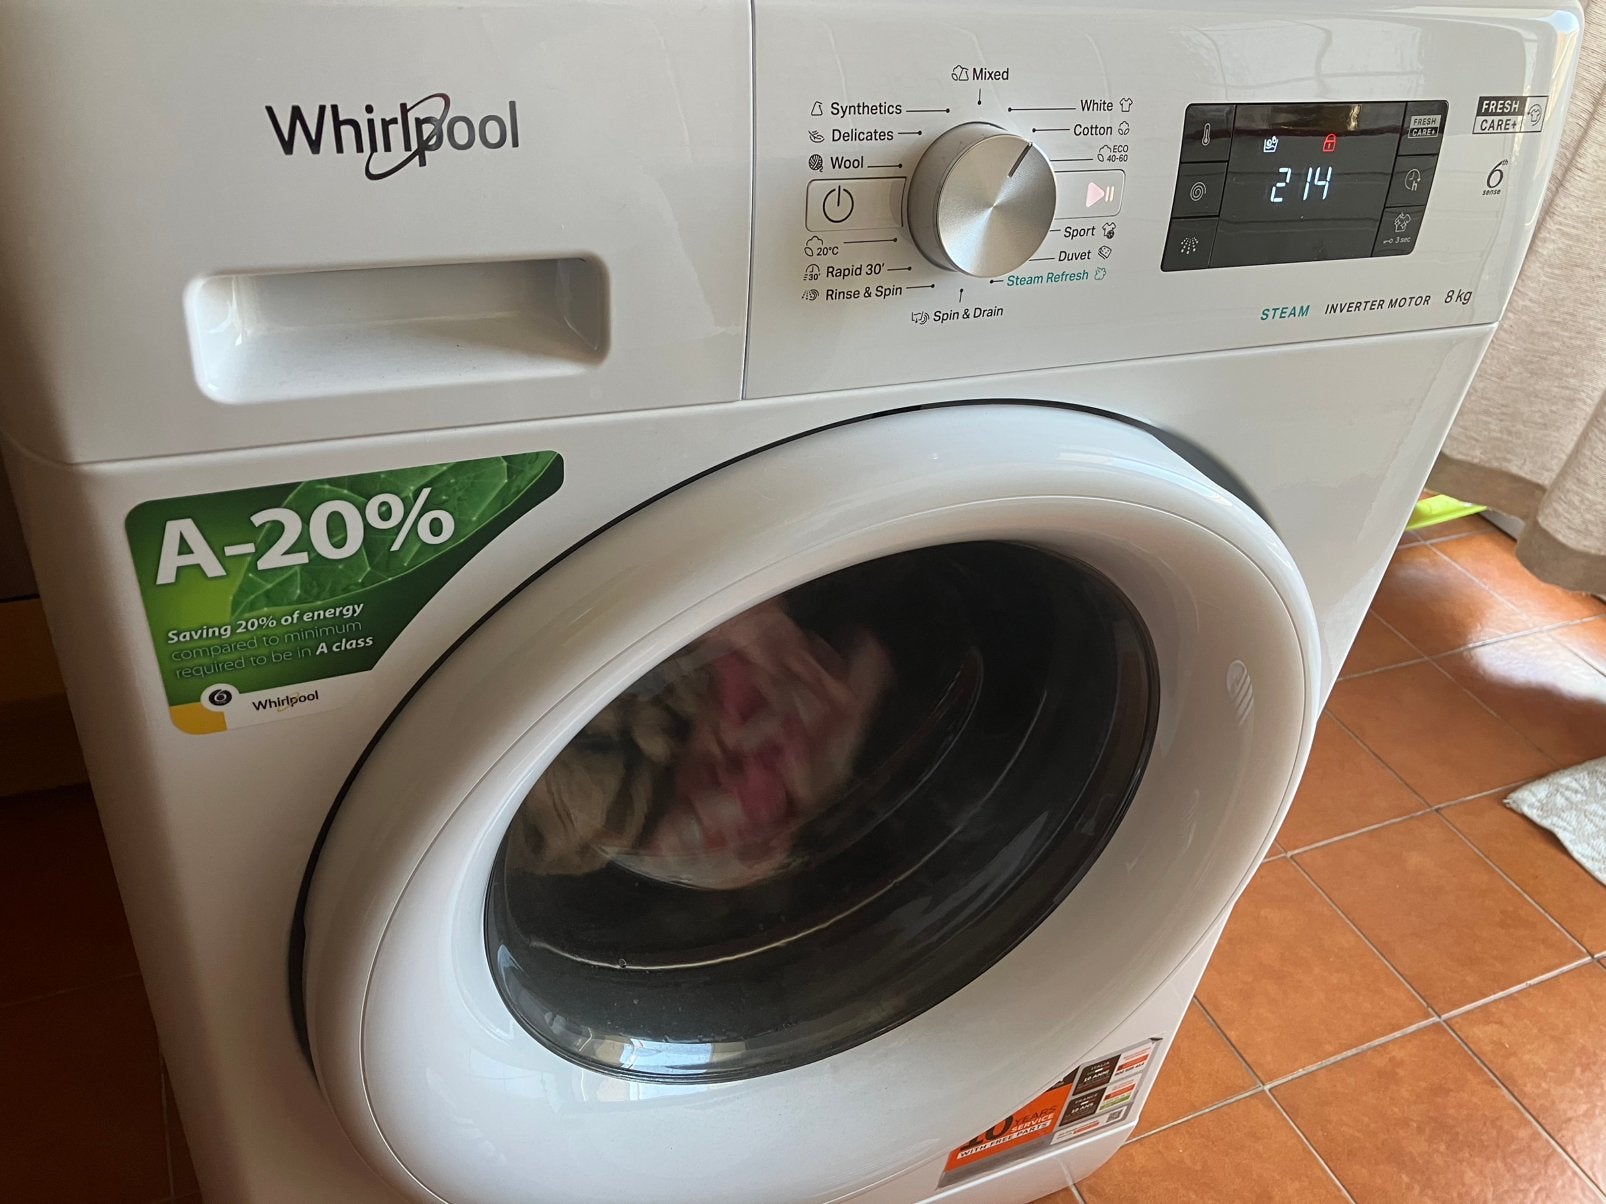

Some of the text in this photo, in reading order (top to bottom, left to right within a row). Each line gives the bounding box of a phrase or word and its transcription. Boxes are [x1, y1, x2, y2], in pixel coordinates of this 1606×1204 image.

[972, 67, 1010, 81] Mixed
[830, 102, 903, 117] Synthetics
[1080, 99, 1114, 112] White
[1481, 100, 1520, 113] FRESH
[1413, 117, 1437, 126] FRESH
[1480, 118, 1517, 132] CARE+
[264, 98, 520, 170] Whirlpool
[831, 128, 895, 142] Delicates
[1073, 123, 1114, 137] Cotton
[1412, 127, 1436, 137] CARE+
[1112, 144, 1129, 153] ECO
[830, 156, 865, 170] Wool
[1106, 153, 1129, 163] 40-60
[1482, 188, 1502, 196] sense
[1063, 225, 1096, 239] Sport
[816, 246, 839, 256] 20°C
[1057, 250, 1092, 262] Duvet
[826, 264, 863, 280] Rapid
[1006, 269, 1089, 287] Steam Refresh
[825, 284, 903, 301] Rinse & Spin
[932, 305, 1004, 323] Spin & Drain
[1260, 304, 1311, 321] STEAM
[1325, 299, 1385, 315] INVERTER
[1387, 294, 1432, 309] MOTOR
[155, 487, 456, 586] A-20%
[167, 602, 365, 644] Saving 20% of energy
[171, 621, 363, 662] compared to minimum
[175, 635, 374, 680] required to be in A class
[252, 689, 320, 712] Whirlpool
[1011, 1112, 1055, 1133] SERVICE
[1014, 1105, 1057, 1126] YEARS
[960, 1143, 988, 1157] WITH
[989, 1134, 1014, 1147] FREE
[1016, 1121, 1048, 1138] PARTS
